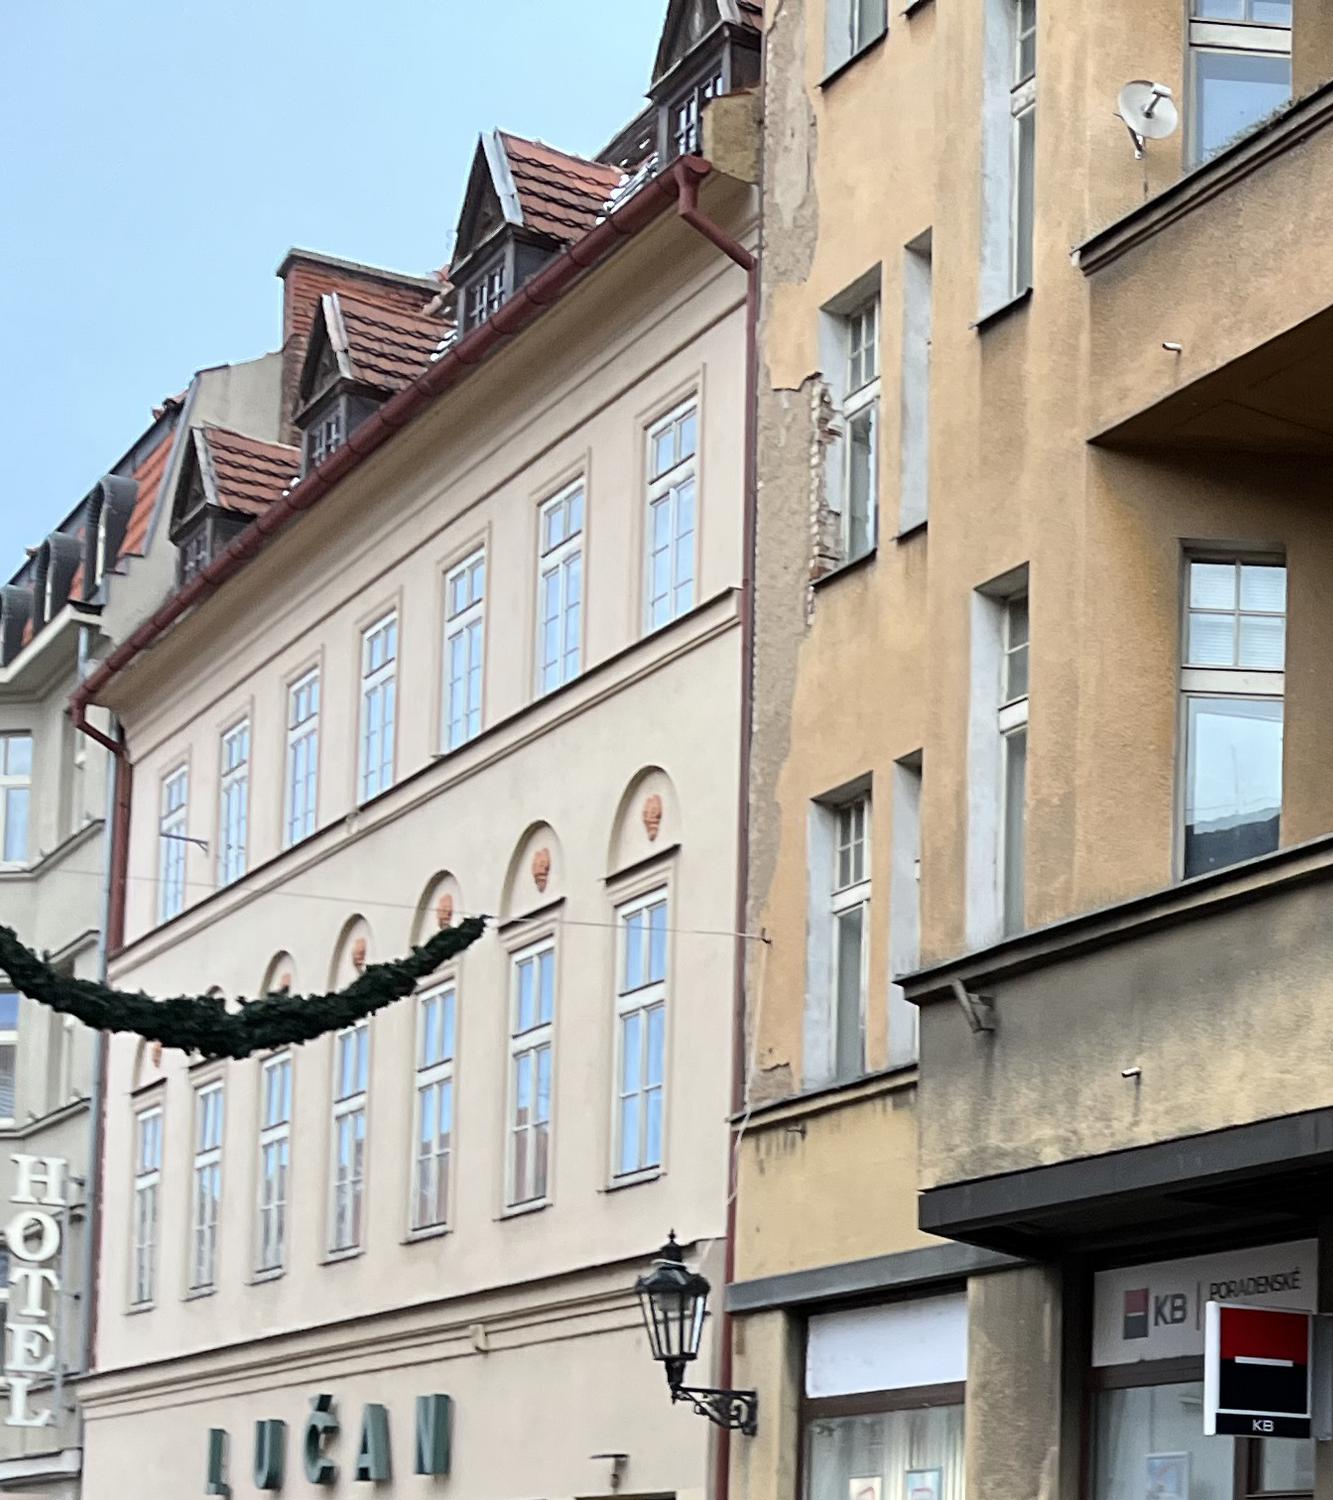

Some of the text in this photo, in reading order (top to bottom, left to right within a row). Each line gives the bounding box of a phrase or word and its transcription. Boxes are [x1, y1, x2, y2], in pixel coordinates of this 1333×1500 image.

[5, 1153, 68, 1428] HOTEL
[1208, 1267, 1301, 1301] PORADENSKÉ
[1154, 1293, 1188, 1327] KB
[1252, 1419, 1275, 1433] KB
[206, 1393, 453, 1496] LUČAN
